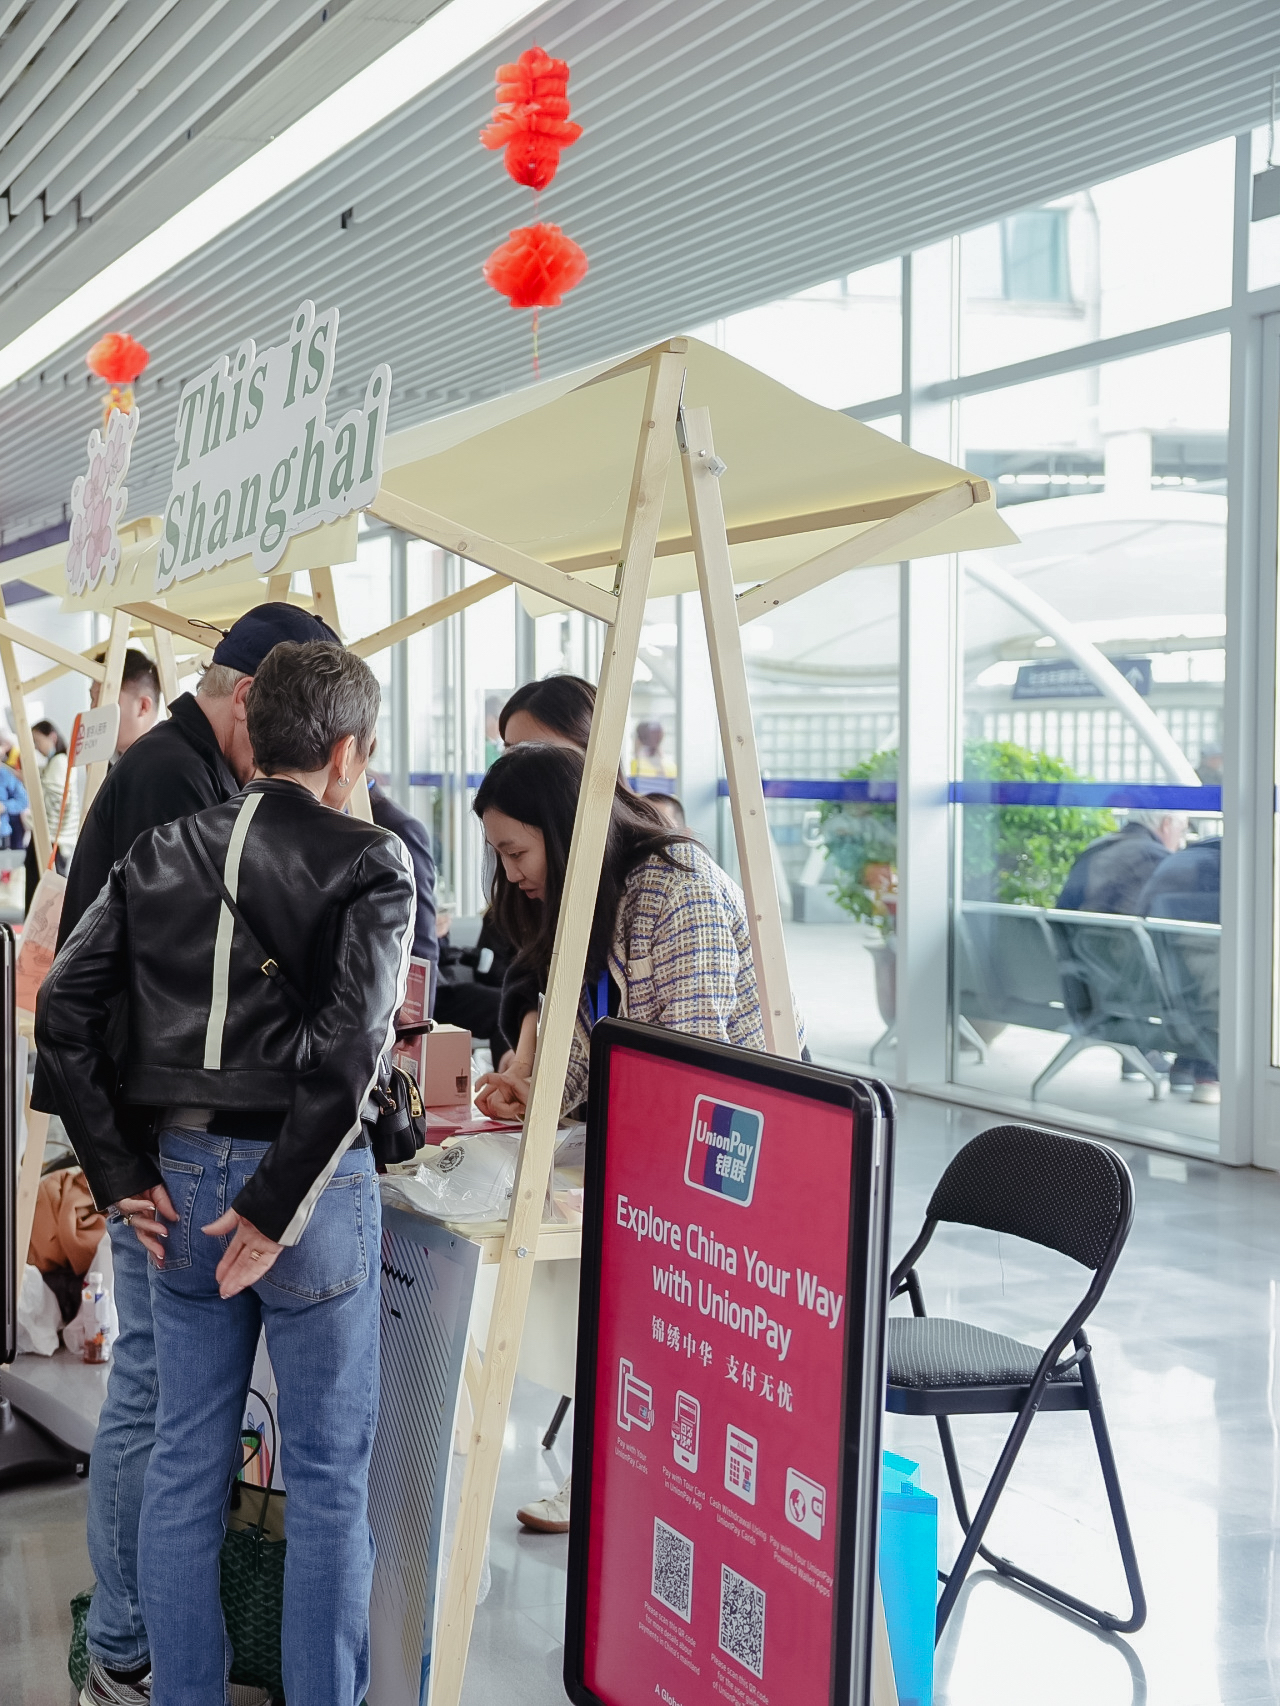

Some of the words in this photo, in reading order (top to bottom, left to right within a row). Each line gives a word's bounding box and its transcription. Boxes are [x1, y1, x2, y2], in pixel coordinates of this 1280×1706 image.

[176, 353, 268, 472] This
[283, 313, 330, 410] is
[158, 376, 383, 580] Shanghai
[695, 1120, 754, 1167] UnionPay
[715, 1153, 747, 1184] 银联
[617, 1194, 681, 1251] Explore
[686, 1224, 737, 1276] China
[743, 1246, 791, 1298] Your
[796, 1268, 843, 1329] Way
[653, 1264, 692, 1307] with
[698, 1279, 792, 1361] UnionPay
[652, 1315, 712, 1367] 锦绣中华
[725, 1355, 793, 1412] 支付无忧
[615, 1448, 636, 1467] UnionPay
[636, 1460, 648, 1475] Cards
[617, 1437, 626, 1449] Pay
[626, 1444, 636, 1454] with
[637, 1449, 647, 1461] Your
[736, 1441, 748, 1453] ATM
[662, 1466, 671, 1479] Pay
[672, 1473, 682, 1485] with
[683, 1479, 694, 1492] Tour
[694, 1486, 705, 1500] Card
[670, 1483, 692, 1505] UnionPay
[692, 1498, 702, 1511] App
[709, 1496, 722, 1511] Cash
[722, 1505, 751, 1529] Withdrawal
[751, 1524, 767, 1542] Using
[717, 1514, 741, 1537] UnionPay
[741, 1530, 756, 1546] Cards
[769, 1535, 780, 1550] Pay
[780, 1545, 793, 1557] with
[794, 1552, 806, 1566] Your
[807, 1561, 833, 1587] UnionPay
[644, 1601, 658, 1618] Please
[658, 1614, 668, 1626] scan
[669, 1621, 678, 1633] this
[678, 1627, 685, 1637] QR
[685, 1635, 696, 1647] code
[652, 1621, 664, 1634] more
[664, 1630, 679, 1646] details
[679, 1642, 692, 1657] about
[655, 1684, 660, 1696] A
[661, 1689, 683, 1706] Glob
[711, 1653, 727, 1672] Please
[727, 1667, 738, 1680] scan
[739, 1675, 748, 1689] this
[749, 1683, 756, 1694] QR
[756, 1691, 769, 1705] code
[712, 1681, 718, 1690] of
[717, 1671, 725, 1682] for
[725, 1678, 734, 1690] the
[734, 1687, 745, 1698] user
